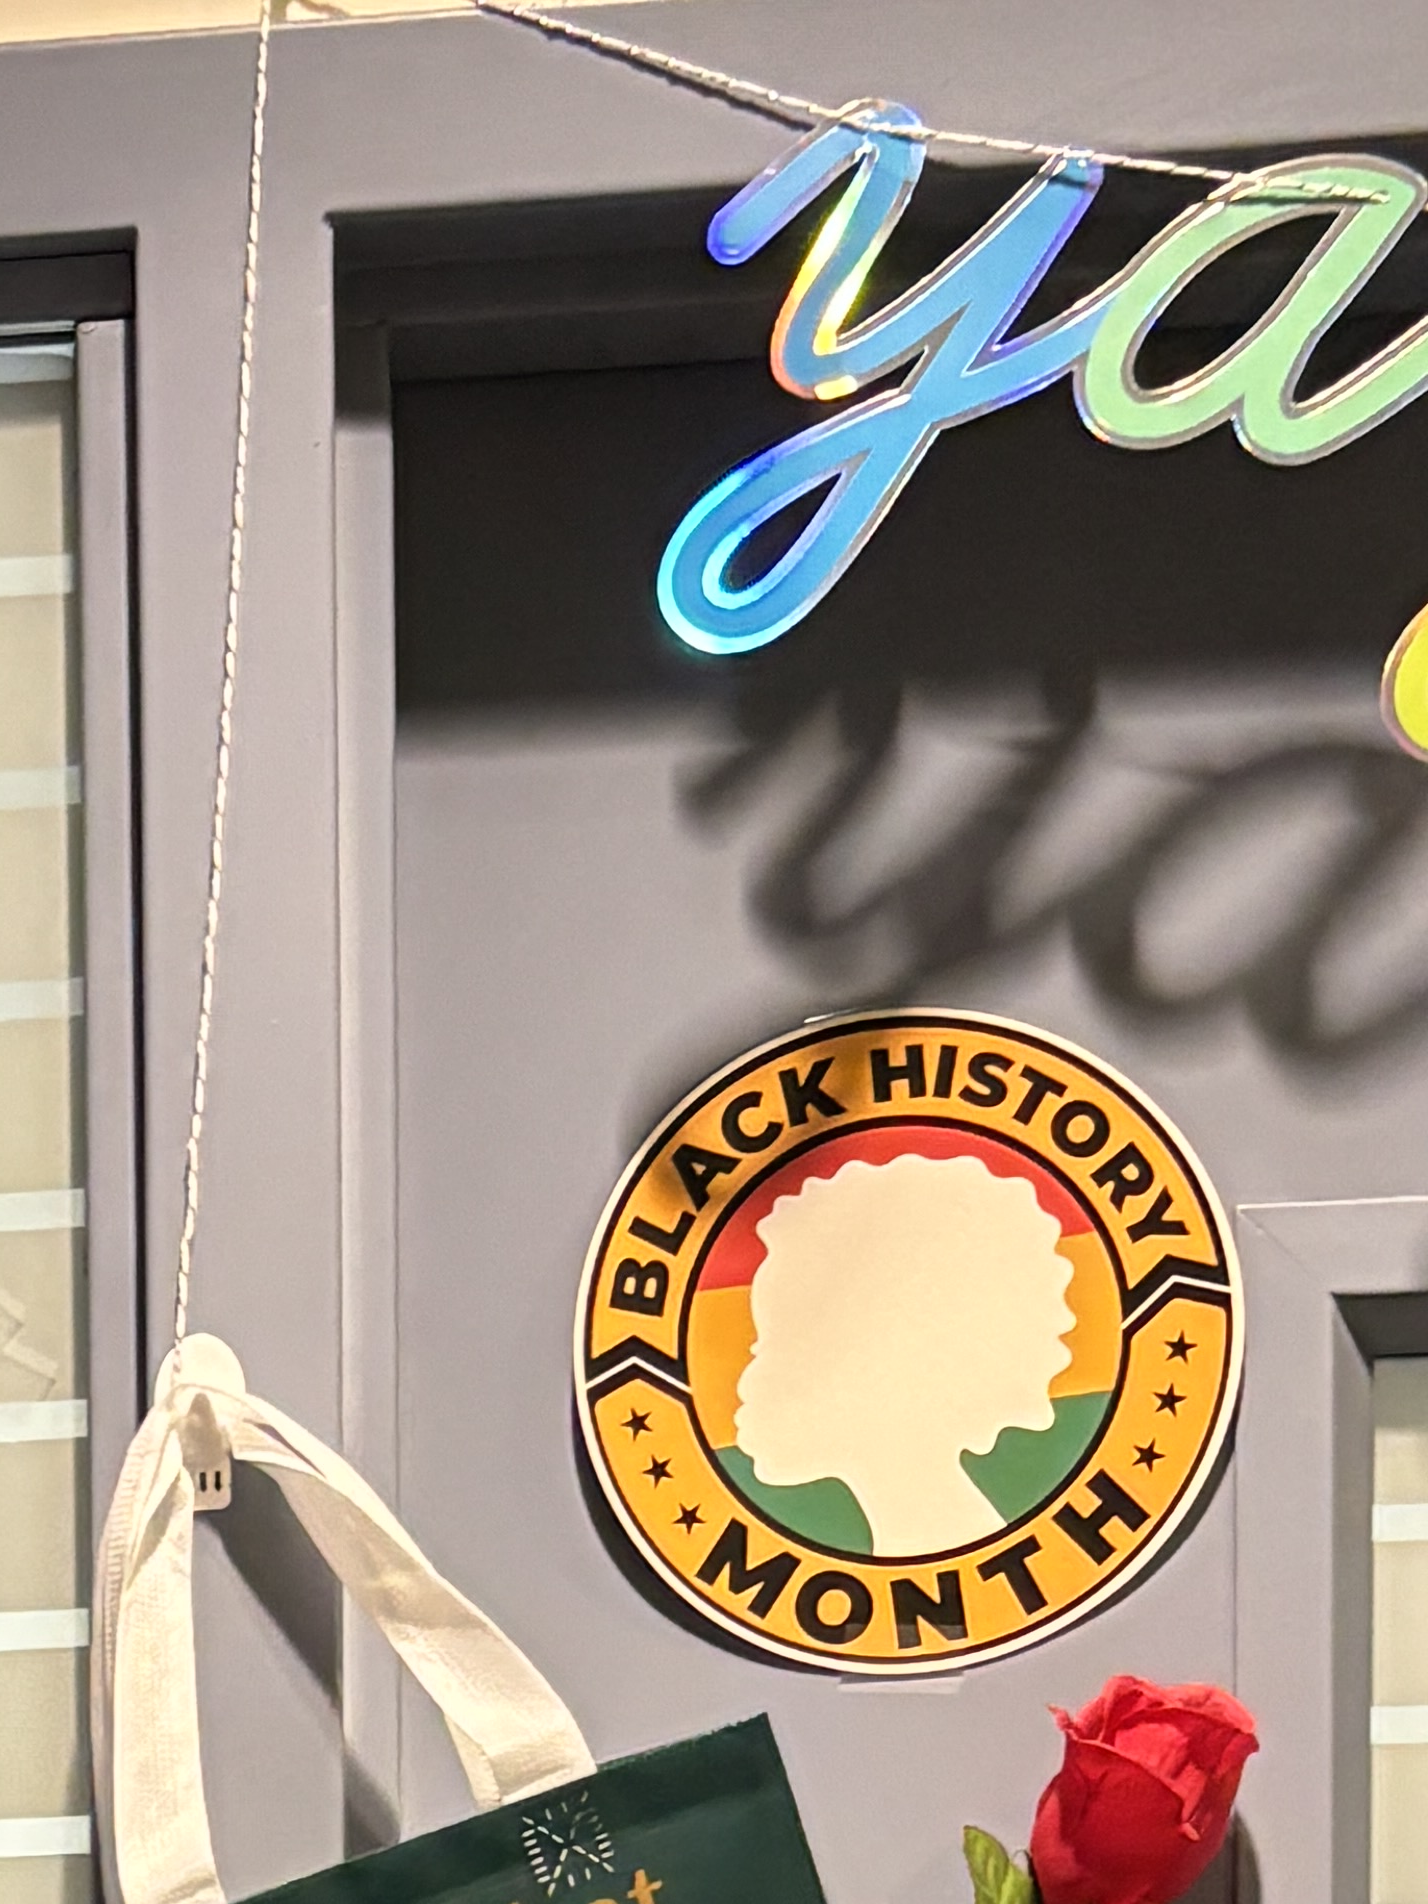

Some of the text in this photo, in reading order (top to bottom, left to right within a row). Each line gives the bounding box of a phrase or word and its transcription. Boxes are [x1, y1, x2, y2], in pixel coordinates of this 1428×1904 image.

[656, 98, 1428, 762] ya
[609, 1044, 1190, 1317] BLACK HISTORY
[696, 1469, 1152, 1650] MONTH
